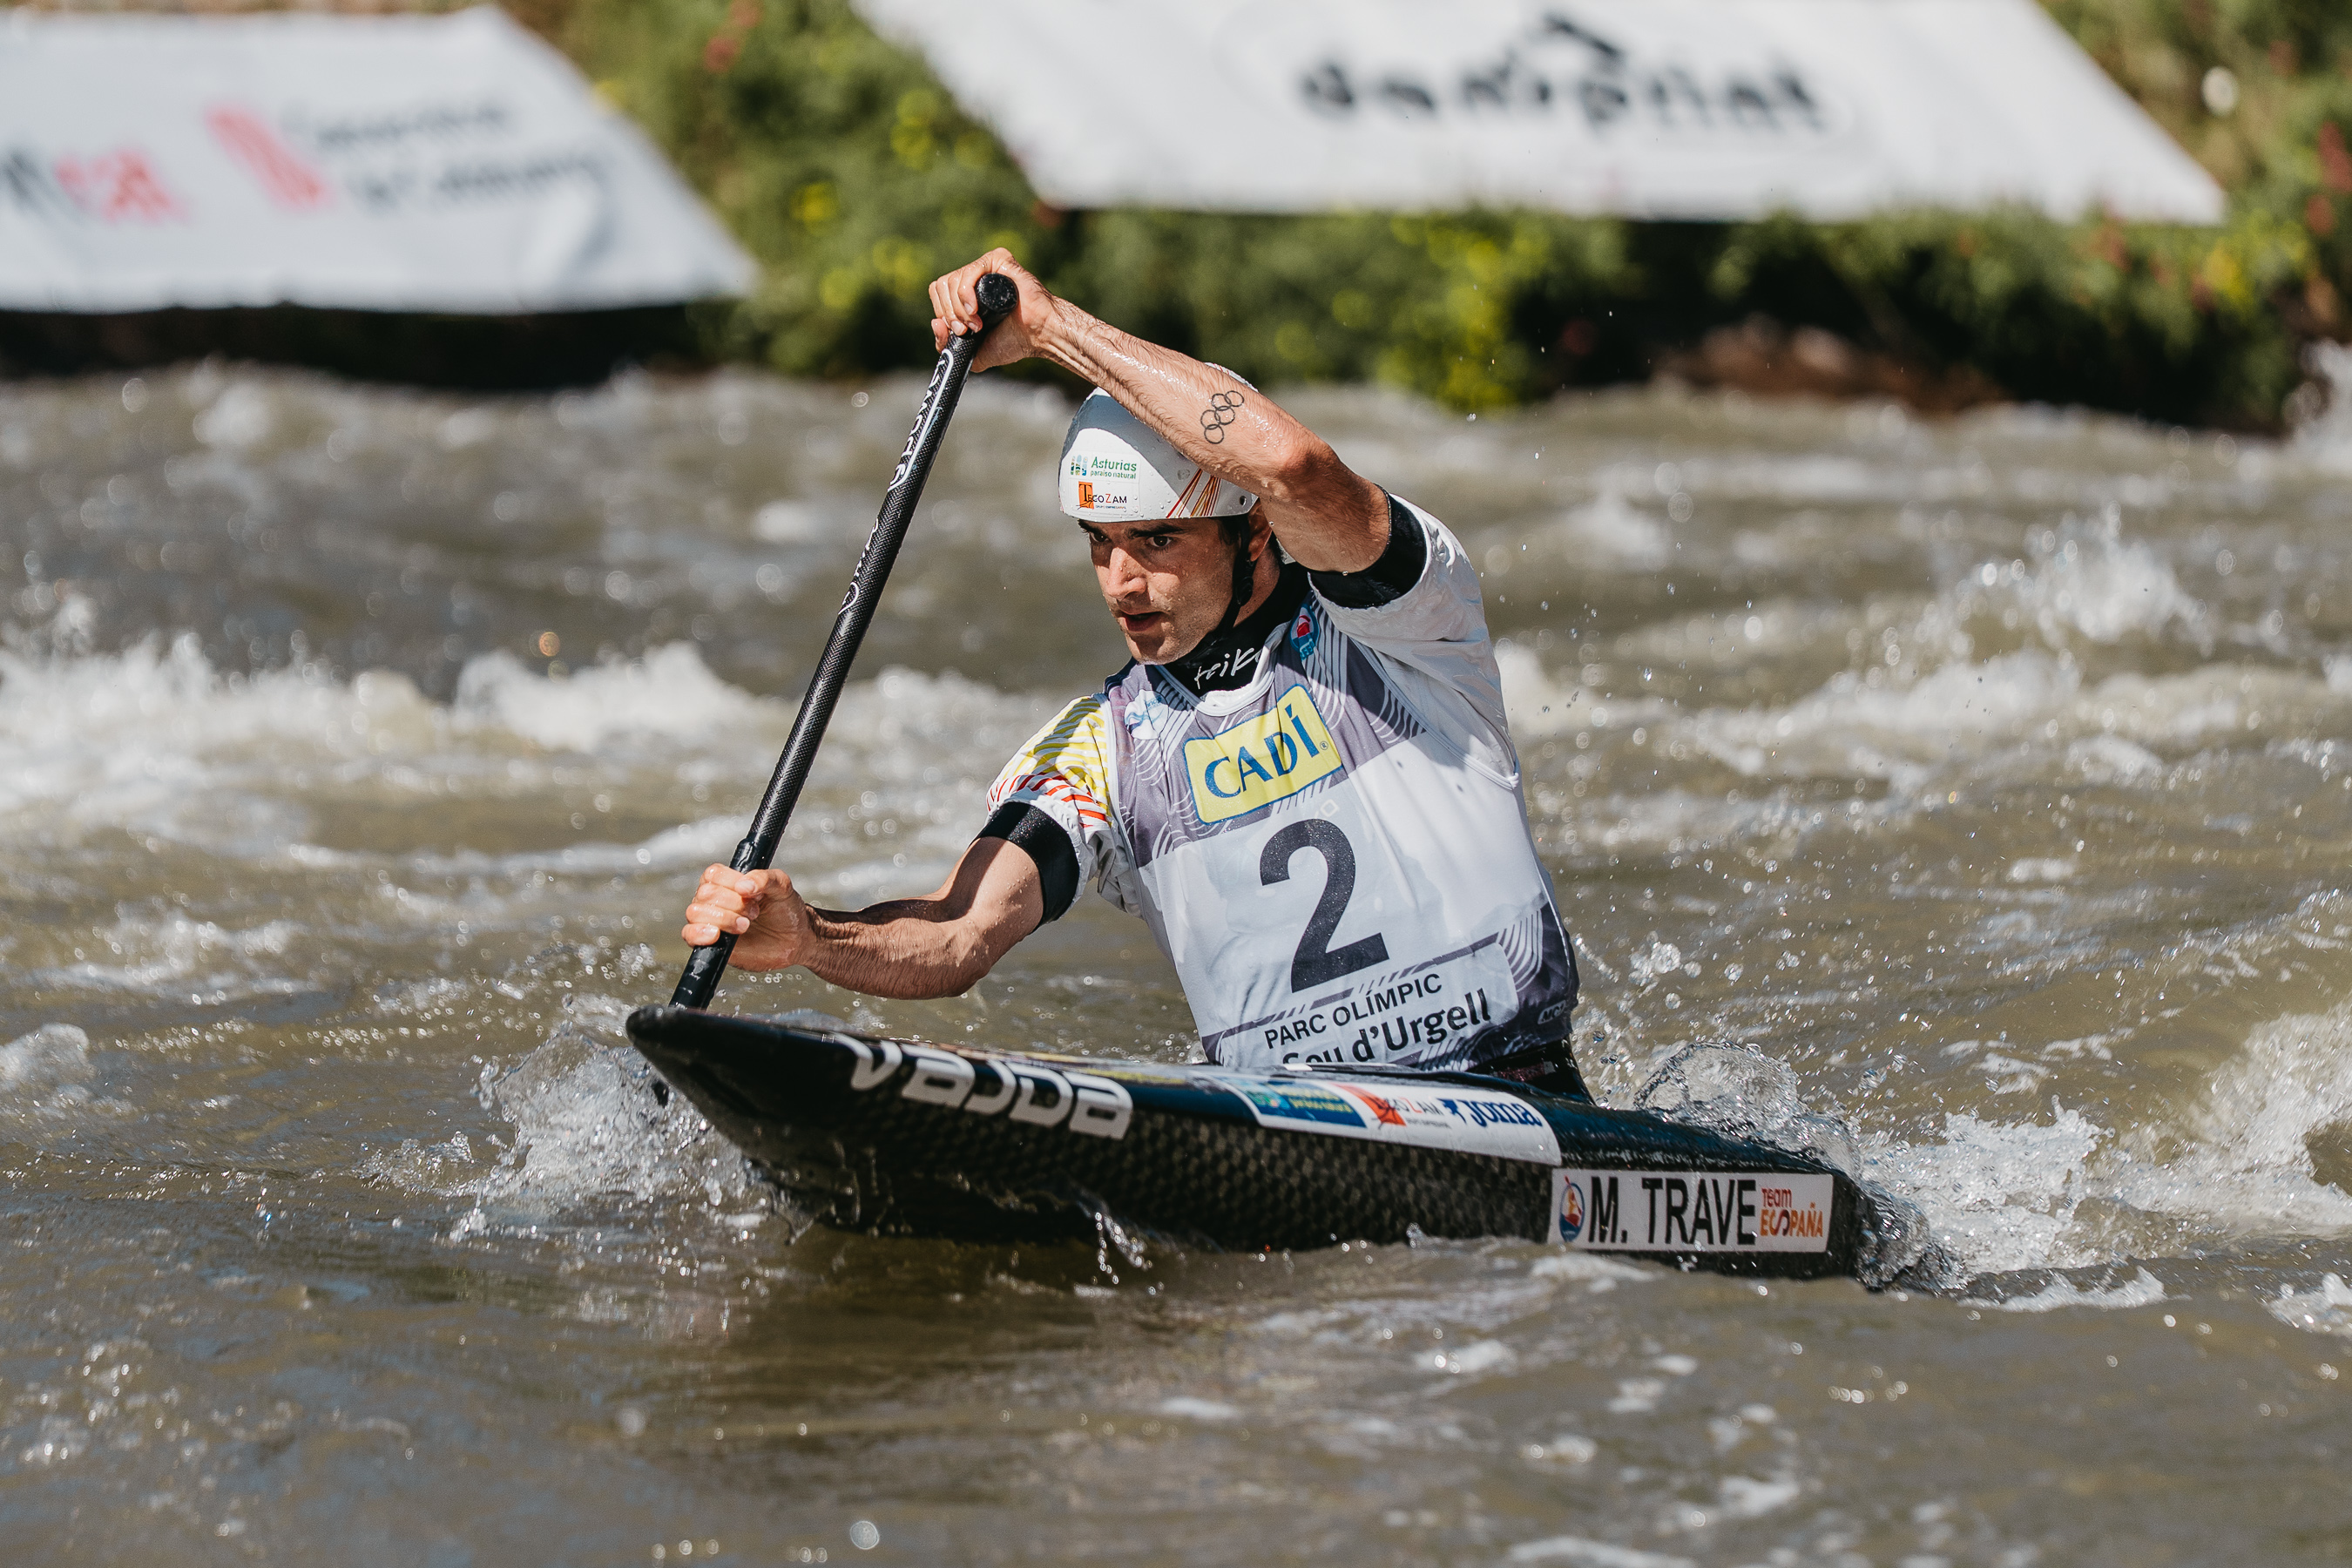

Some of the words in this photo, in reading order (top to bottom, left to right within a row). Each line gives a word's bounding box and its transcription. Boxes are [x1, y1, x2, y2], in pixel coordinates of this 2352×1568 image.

[1091, 456, 1138, 472] Asturias
[1112, 471, 1137, 480] natural
[1204, 703, 1321, 799] CADÍ
[1259, 818, 1390, 993] 2
[1264, 1013, 1328, 1050] PARC
[1332, 972, 1443, 1027] OLÍMPIC
[1351, 987, 1492, 1063] d'Urgell
[1587, 1175, 1628, 1244] M.
[1641, 1177, 1757, 1246] TRAVE
